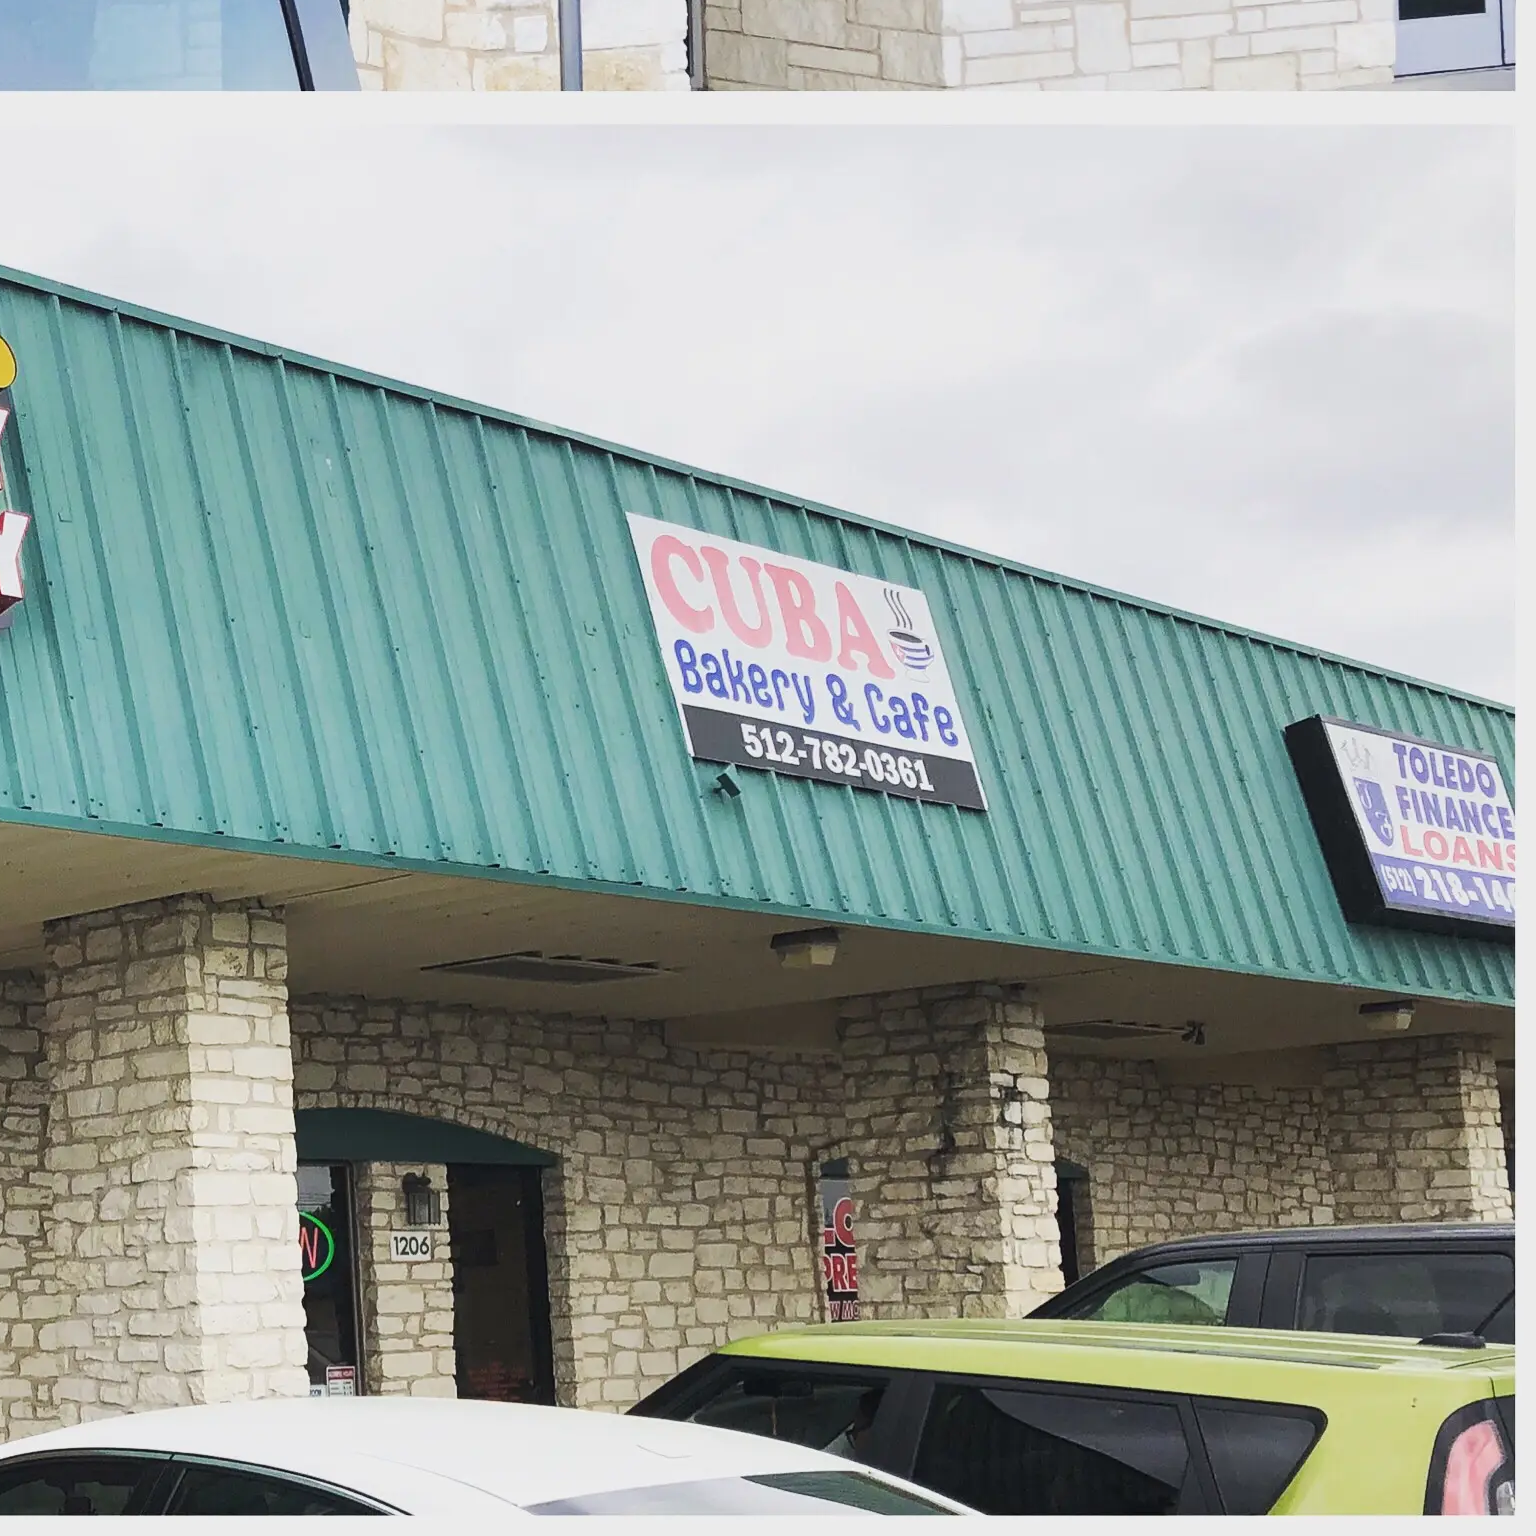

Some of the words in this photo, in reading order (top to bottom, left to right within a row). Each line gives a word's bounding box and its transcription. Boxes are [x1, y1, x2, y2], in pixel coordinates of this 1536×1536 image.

[651, 534, 896, 680] CUBA
[674, 639, 815, 725] Bakery
[826, 673, 861, 731] &
[864, 683, 959, 747] Cafe
[740, 723, 935, 792] 512-782-0361
[1392, 742, 1496, 799] TOLEDO
[1395, 785, 1515, 841] FINANCE
[1380, 864, 1418, 896] (512)
[393, 1236, 430, 1256] 1206
